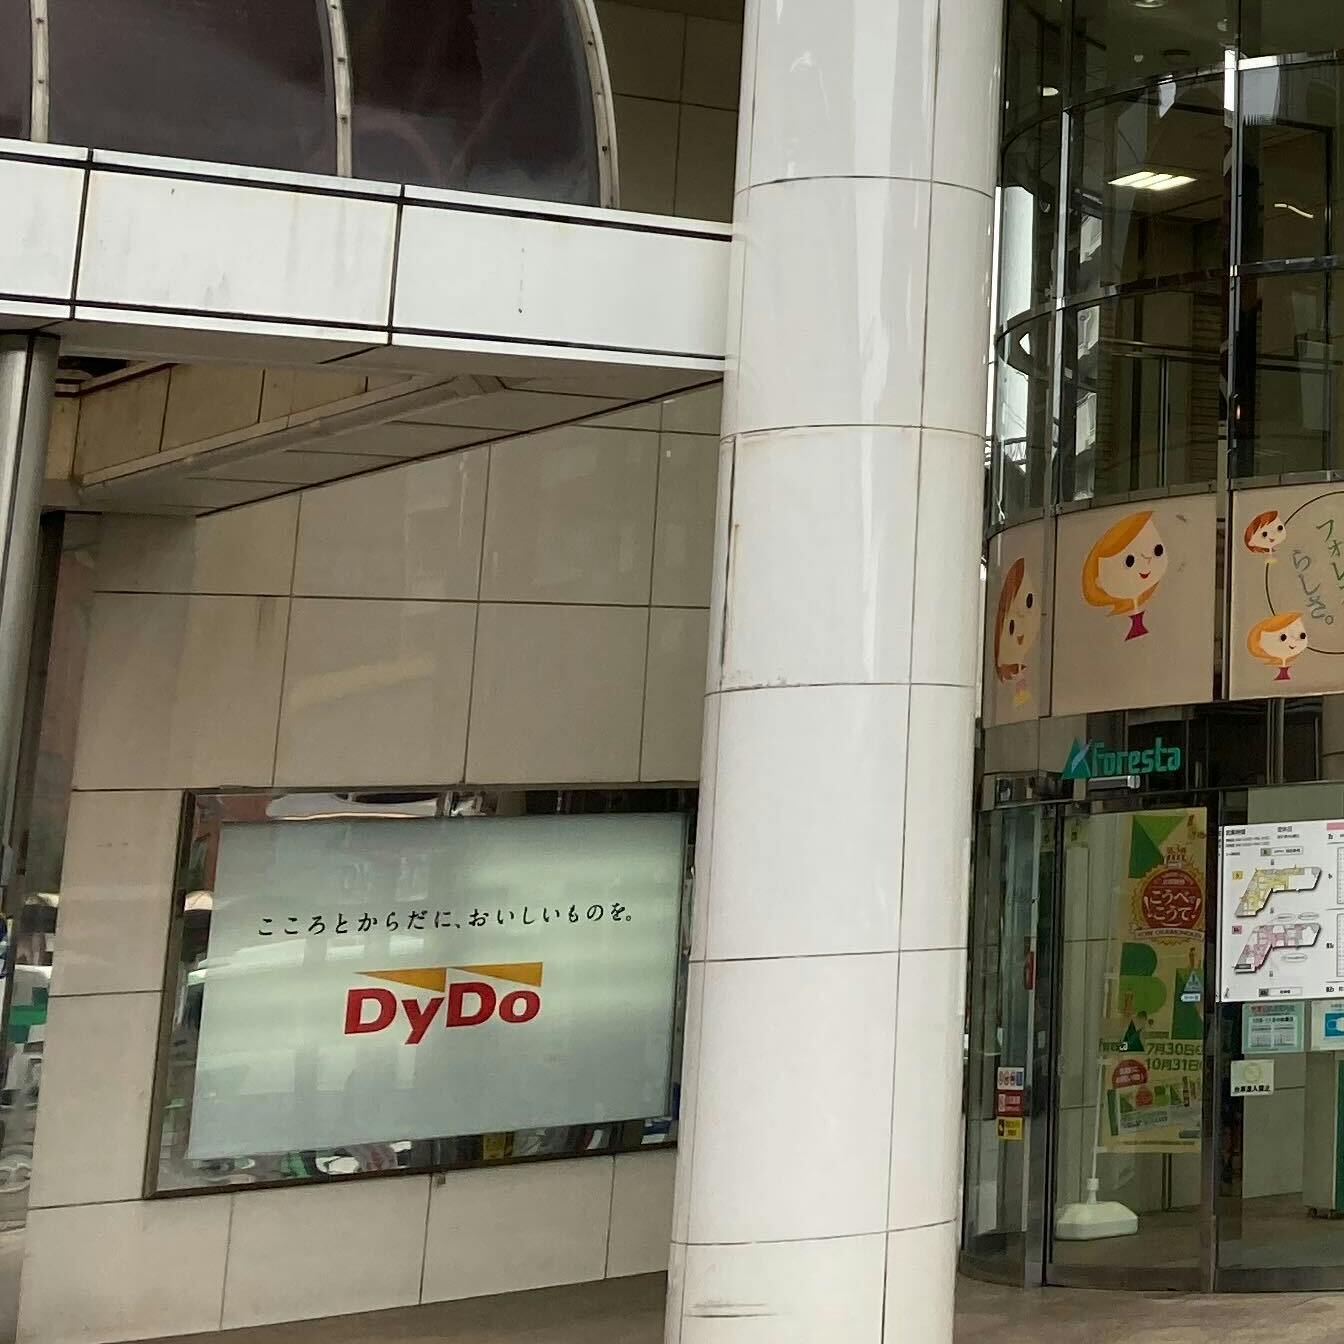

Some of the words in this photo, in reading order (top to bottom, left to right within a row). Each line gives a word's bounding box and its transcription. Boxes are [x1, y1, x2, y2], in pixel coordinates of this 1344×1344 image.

[1091, 736, 1181, 777] Foresta
[258, 902, 632, 937] こころとからだに、おいしいものを。
[344, 981, 541, 1045] DyDo
